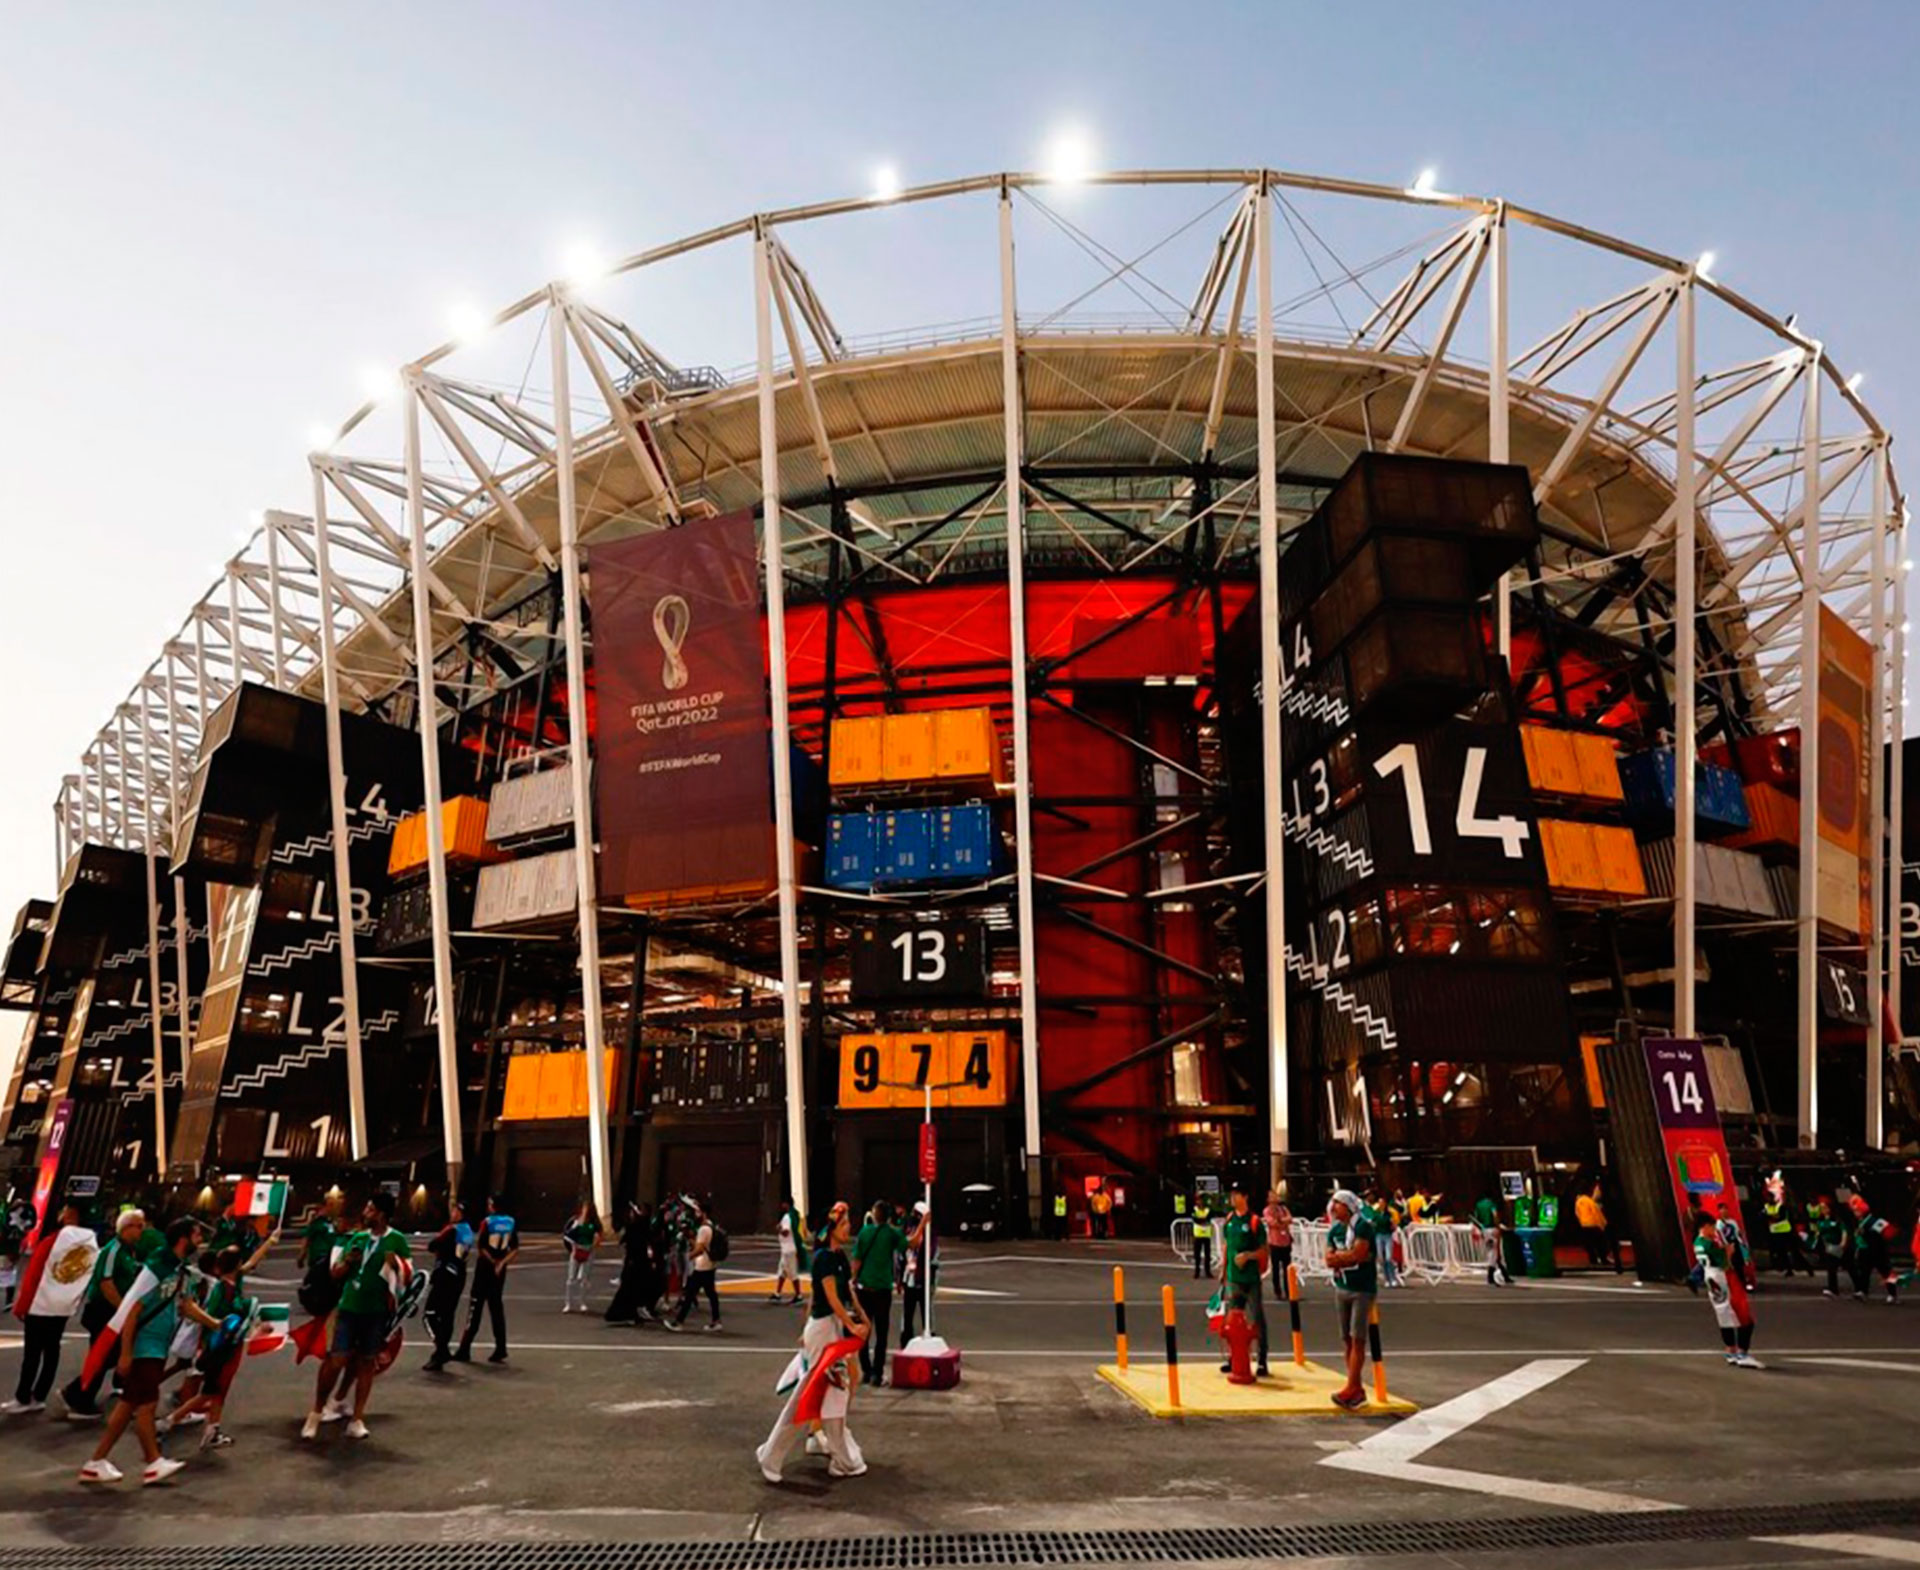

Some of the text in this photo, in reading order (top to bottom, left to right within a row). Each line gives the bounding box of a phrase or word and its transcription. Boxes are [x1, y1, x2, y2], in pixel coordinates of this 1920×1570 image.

[631, 691, 724, 718] FIFA WORLD CUP
[1293, 757, 1330, 832] L3
[1372, 743, 1530, 858] 14
[219, 883, 263, 972] 11
[891, 929, 946, 982] 13
[1309, 909, 1350, 980] L2
[1829, 963, 1856, 1013] 15
[1662, 1071, 1704, 1114] 14
